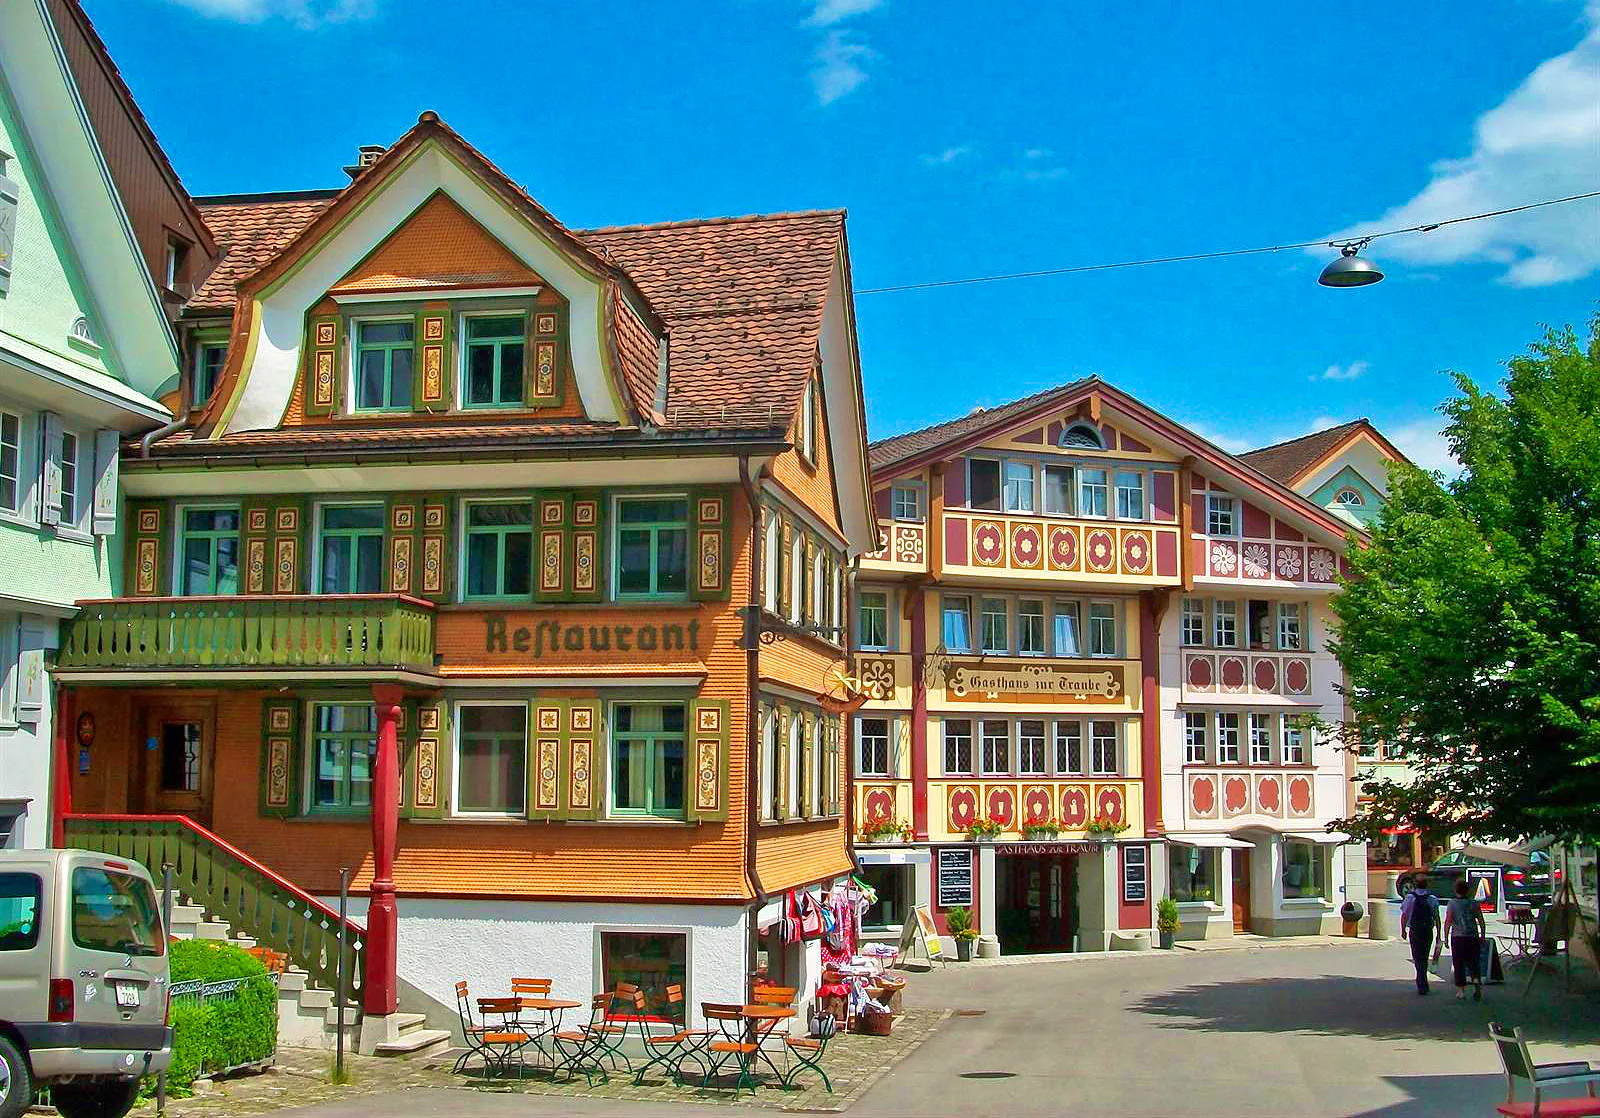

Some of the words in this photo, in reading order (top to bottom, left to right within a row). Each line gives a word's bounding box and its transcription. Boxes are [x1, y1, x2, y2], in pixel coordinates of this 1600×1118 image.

[969, 675, 1030, 691] Gasthaus
[1035, 680, 1054, 690] zur
[1058, 676, 1101, 691] Traube
